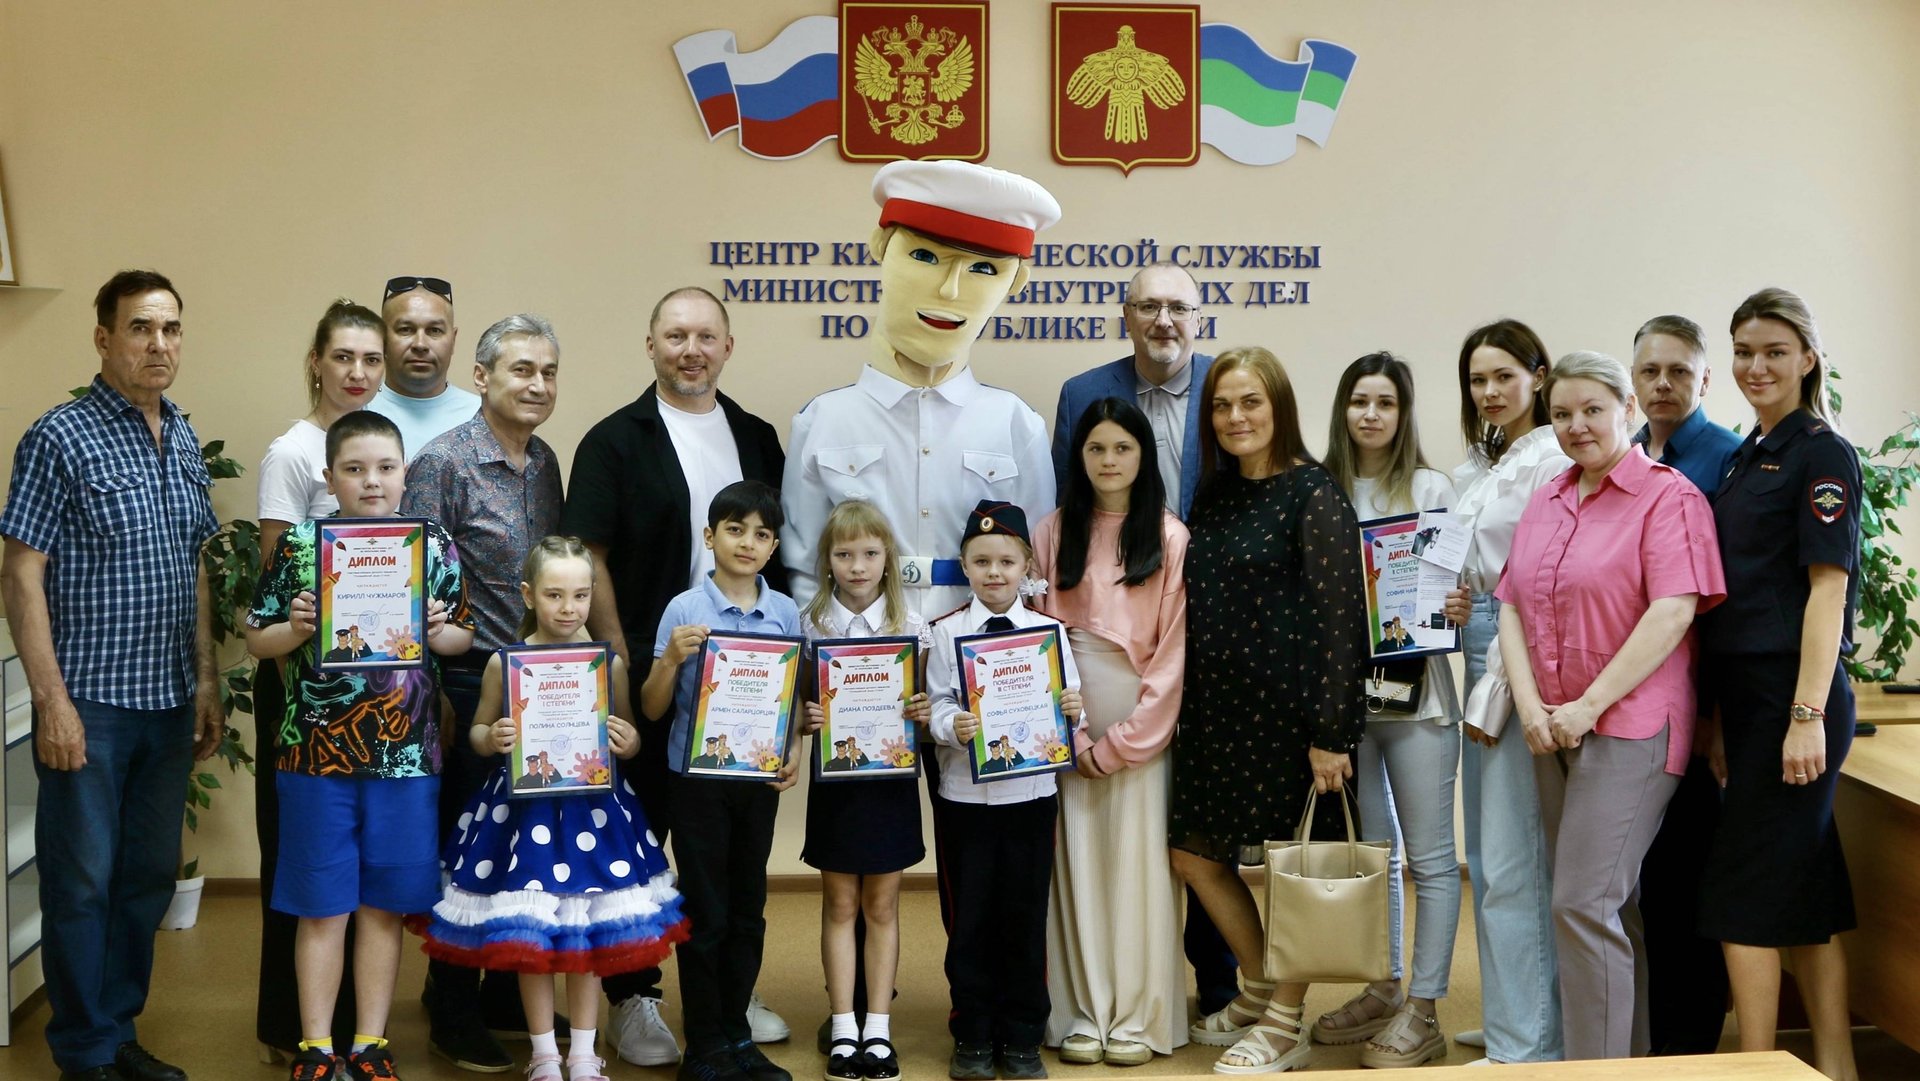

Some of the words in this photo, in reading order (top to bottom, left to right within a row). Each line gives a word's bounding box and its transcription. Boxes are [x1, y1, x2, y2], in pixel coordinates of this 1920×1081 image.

[709, 241, 820, 269] ЦЕНТР
[1171, 244, 1322, 269] СЛУЖБЫ
[1245, 281, 1312, 309] ДЕЛ
[820, 314, 869, 338] ПО
[1814, 483, 1843, 493] РОССИЯ
[348, 556, 396, 568] ДИПЛОМ
[730, 668, 768, 678] ДИПЛОМ
[992, 664, 1032, 678] ДИПЛОМ
[844, 673, 889, 685] ДИПЛОМ
[993, 675, 1034, 686] ПОБЕДИТЕЛЯ
[538, 680, 579, 692] ДИПЛОМ
[1003, 683, 1031, 691] СТЕПЕНИ
[537, 693, 580, 701] ПОБЕДИТЕЛЯ
